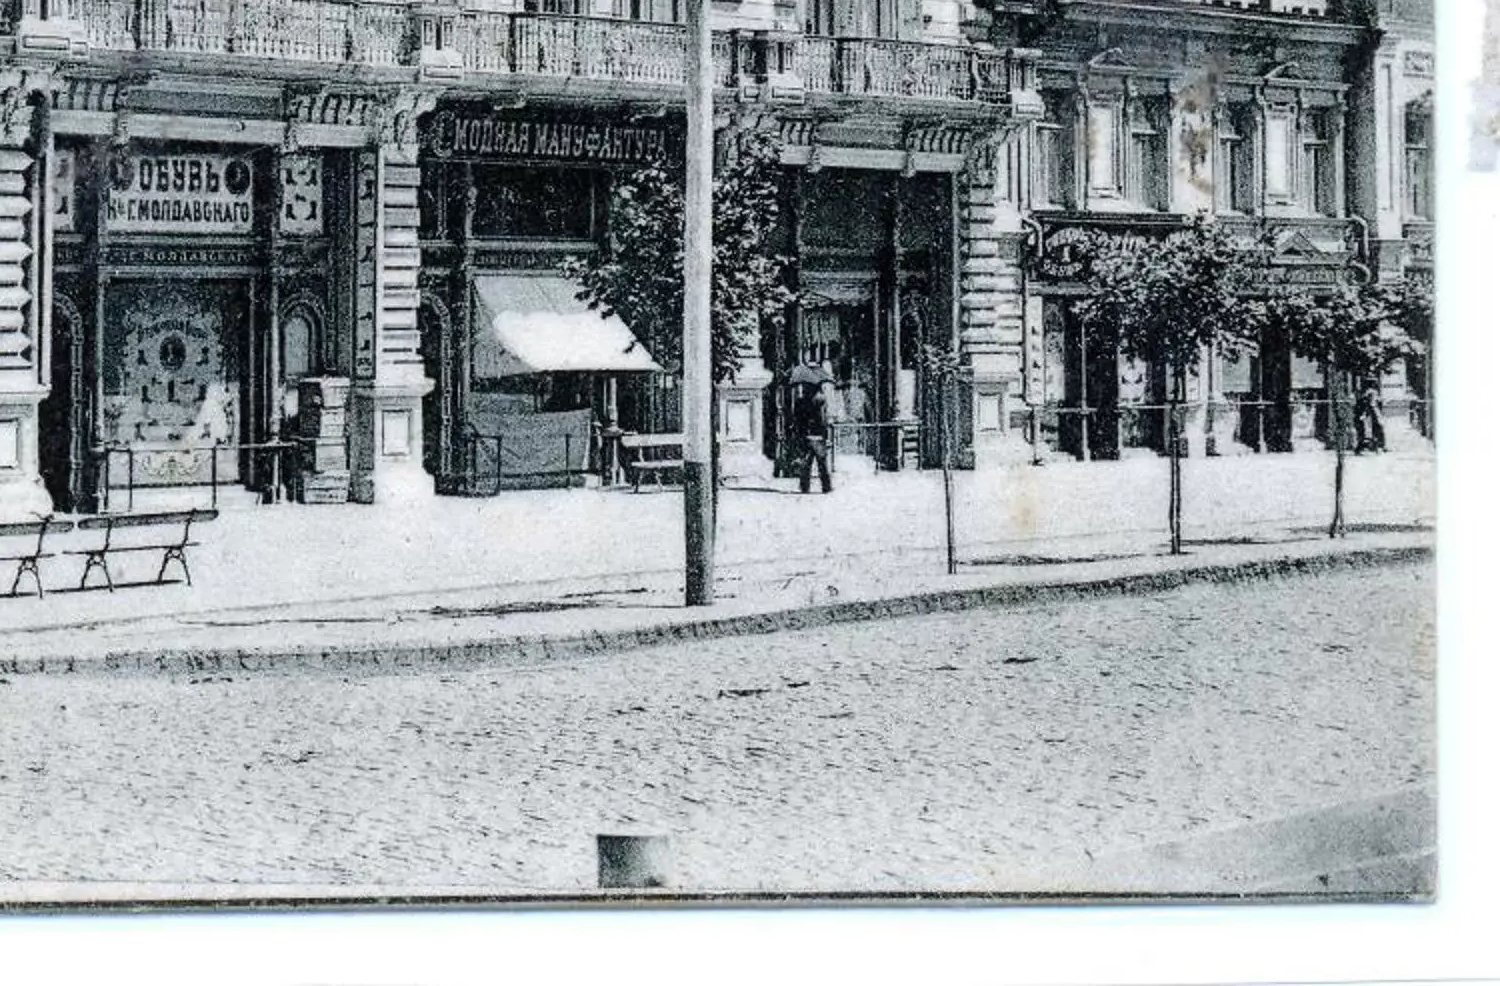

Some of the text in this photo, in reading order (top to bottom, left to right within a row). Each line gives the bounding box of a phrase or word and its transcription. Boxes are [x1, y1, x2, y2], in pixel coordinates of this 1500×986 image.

[452, 117, 668, 161] МОДНАЯ МАНУФАКТУРА
[138, 158, 221, 193] ОБУВЬ
